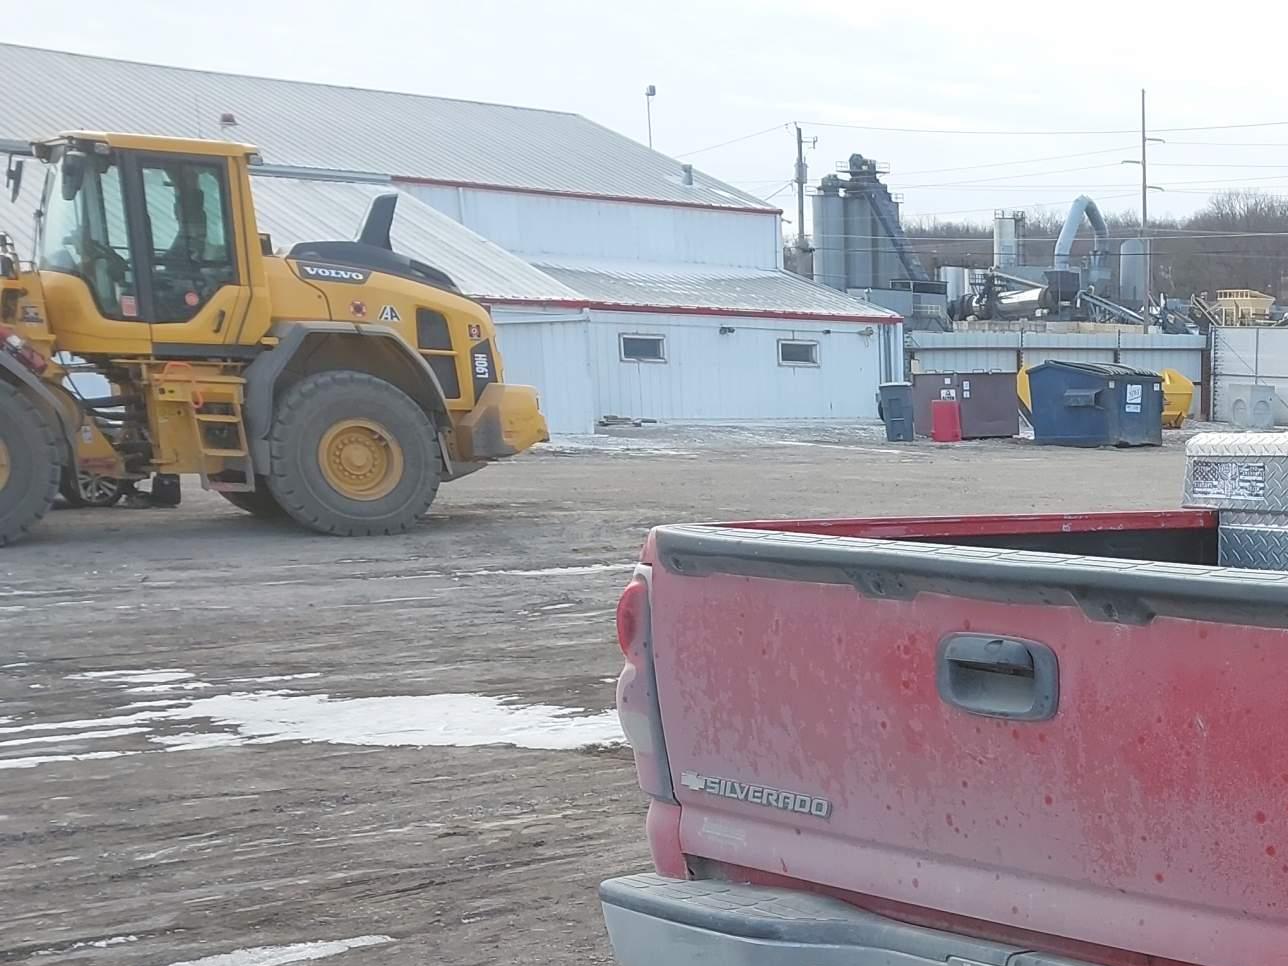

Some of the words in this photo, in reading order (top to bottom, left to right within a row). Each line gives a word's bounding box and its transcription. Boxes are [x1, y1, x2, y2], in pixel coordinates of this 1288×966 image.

[303, 266, 364, 281] VOLVO
[473, 353, 489, 379] L90H
[704, 776, 829, 818] SILVERADO
